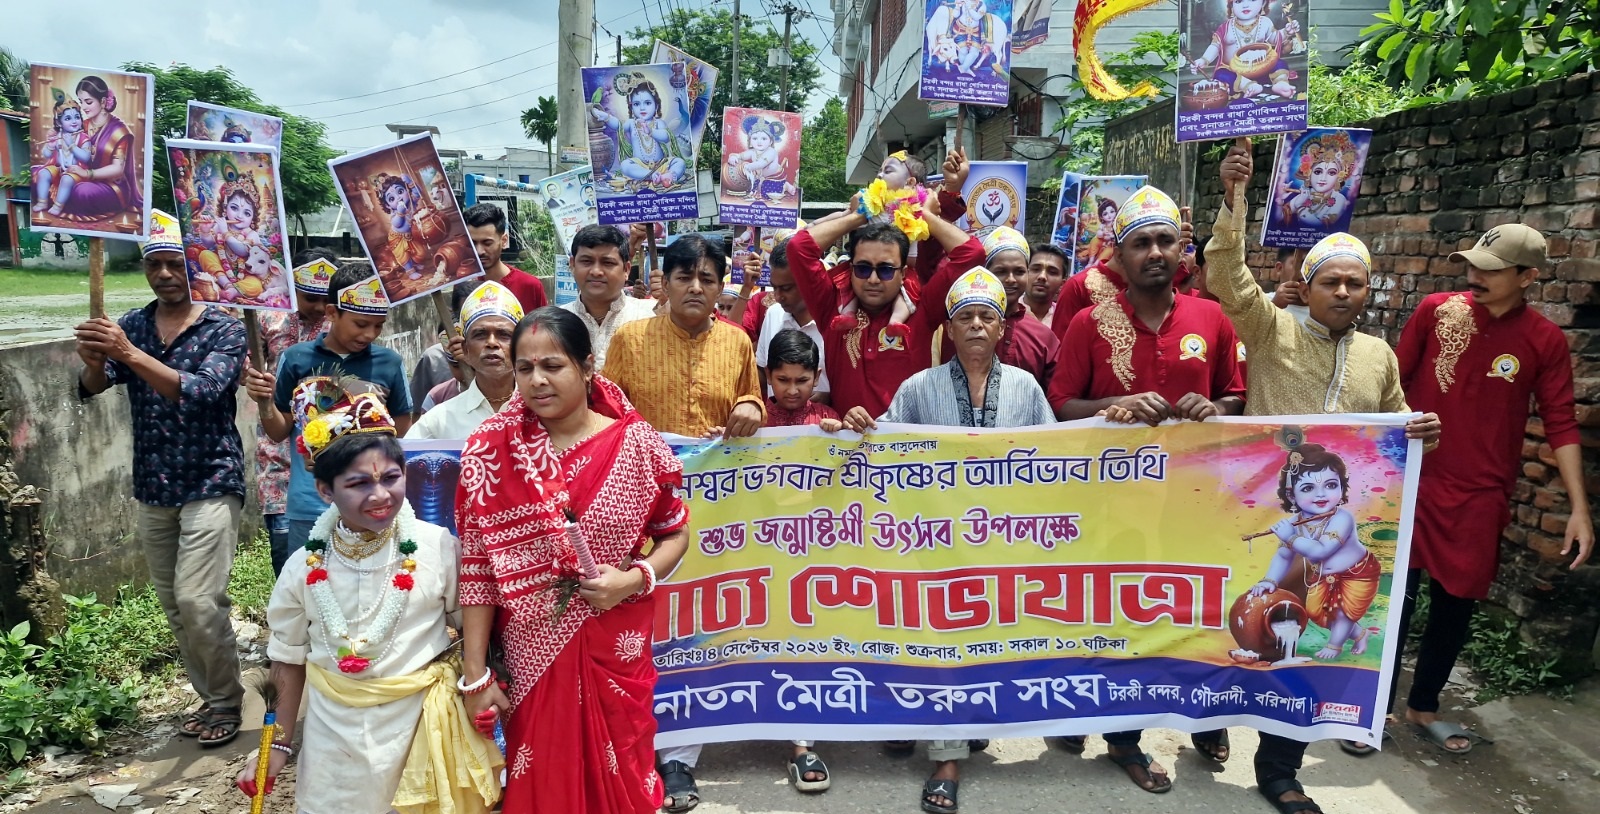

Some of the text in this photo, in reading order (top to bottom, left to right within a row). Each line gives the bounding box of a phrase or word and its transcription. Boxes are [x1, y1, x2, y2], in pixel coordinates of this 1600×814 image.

[1180, 104, 1305, 123] টরকী বন্দর রাধা গোবিন্দ মন্দির
[1201, 121, 1232, 129] সনাতন
[1234, 118, 1255, 127] মৈত্রী
[890, 440, 938, 453] বাসুদেবায়
[742, 464, 835, 491] ভগবান
[840, 452, 957, 503] শ্রীকৃষ্ণের
[1098, 446, 1168, 481] তিথি
[700, 503, 1080, 555] শুভ জন্মাষ্টমী উৎসব উপলক্ষে
[789, 562, 1231, 631] শোভাযাত্রা
[707, 648, 716, 660] ৪
[723, 639, 780, 656] সেপ্টেম্বর
[786, 641, 827, 654] ২০২৬
[833, 638, 856, 656] ইং,
[905, 644, 962, 661] শুক্রবার,
[1008, 638, 1049, 652] সকাল
[1056, 638, 1076, 650] ১০
[1082, 636, 1127, 650] ঘটিকা
[654, 681, 764, 720] নাতন
[771, 667, 875, 714] মৈত্রী
[884, 681, 1003, 714] তরুন
[1011, 673, 1106, 710] সংঘ
[1107, 679, 1143, 701] টরকী
[1147, 684, 1185, 704] বন্দর,
[1191, 683, 1248, 707] গৌরনদী,
